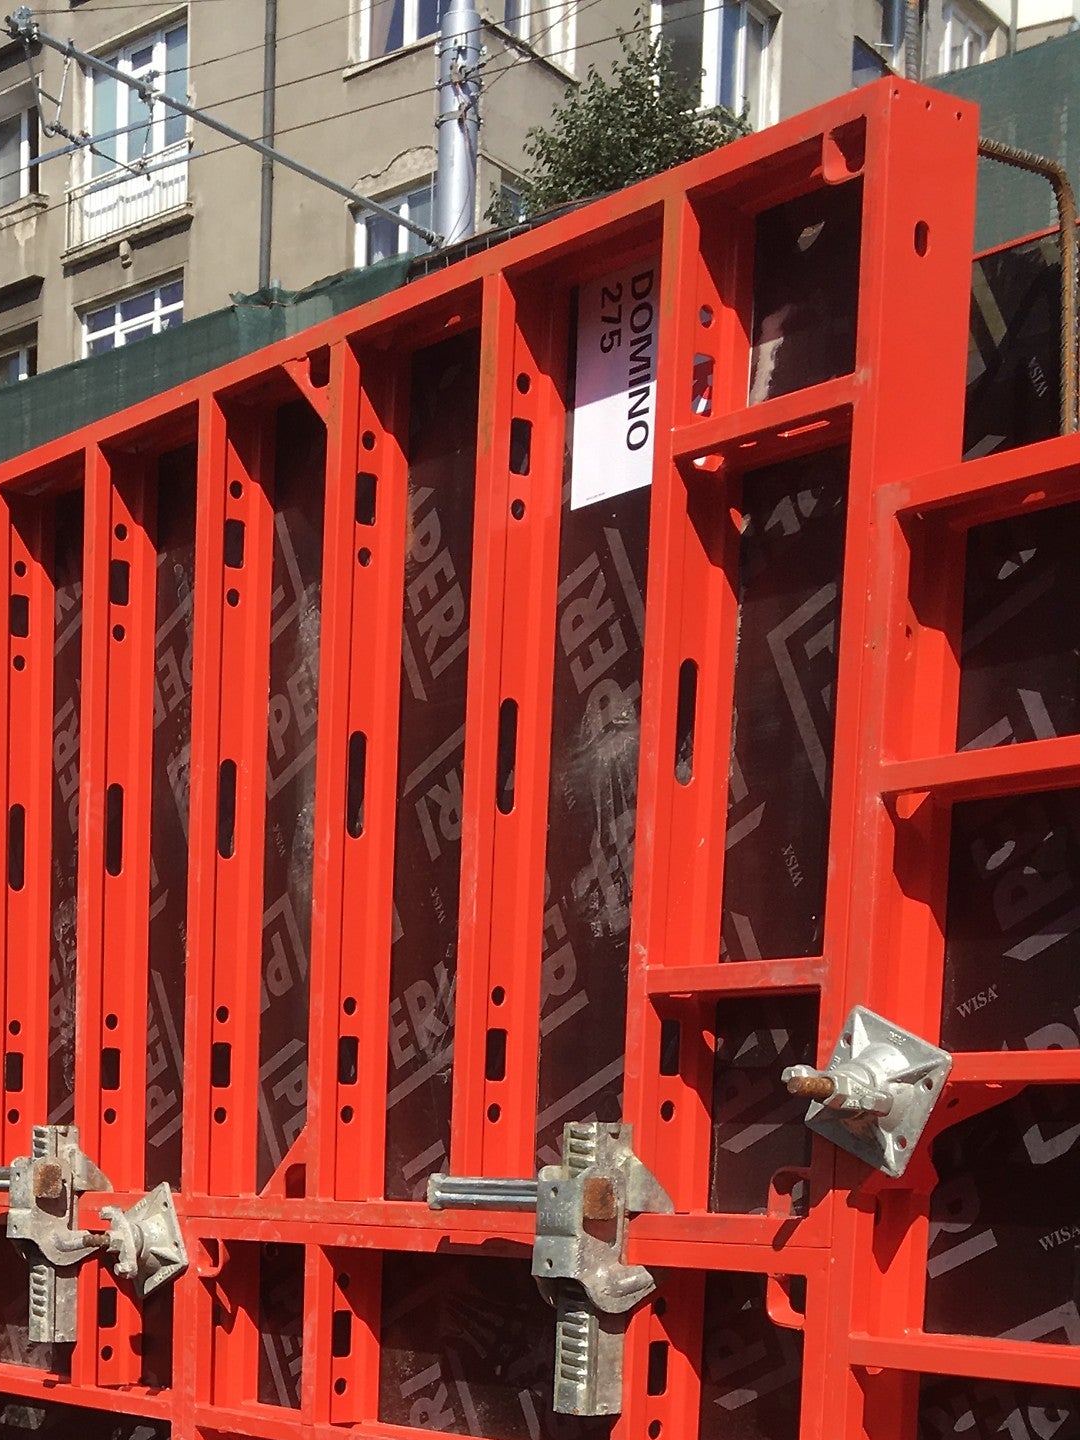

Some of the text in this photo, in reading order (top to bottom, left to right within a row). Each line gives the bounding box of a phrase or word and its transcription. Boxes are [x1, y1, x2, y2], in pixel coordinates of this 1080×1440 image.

[599, 281, 623, 354] 275
[625, 269, 655, 452] DOMINO
[956, 985, 996, 1019] WISA
